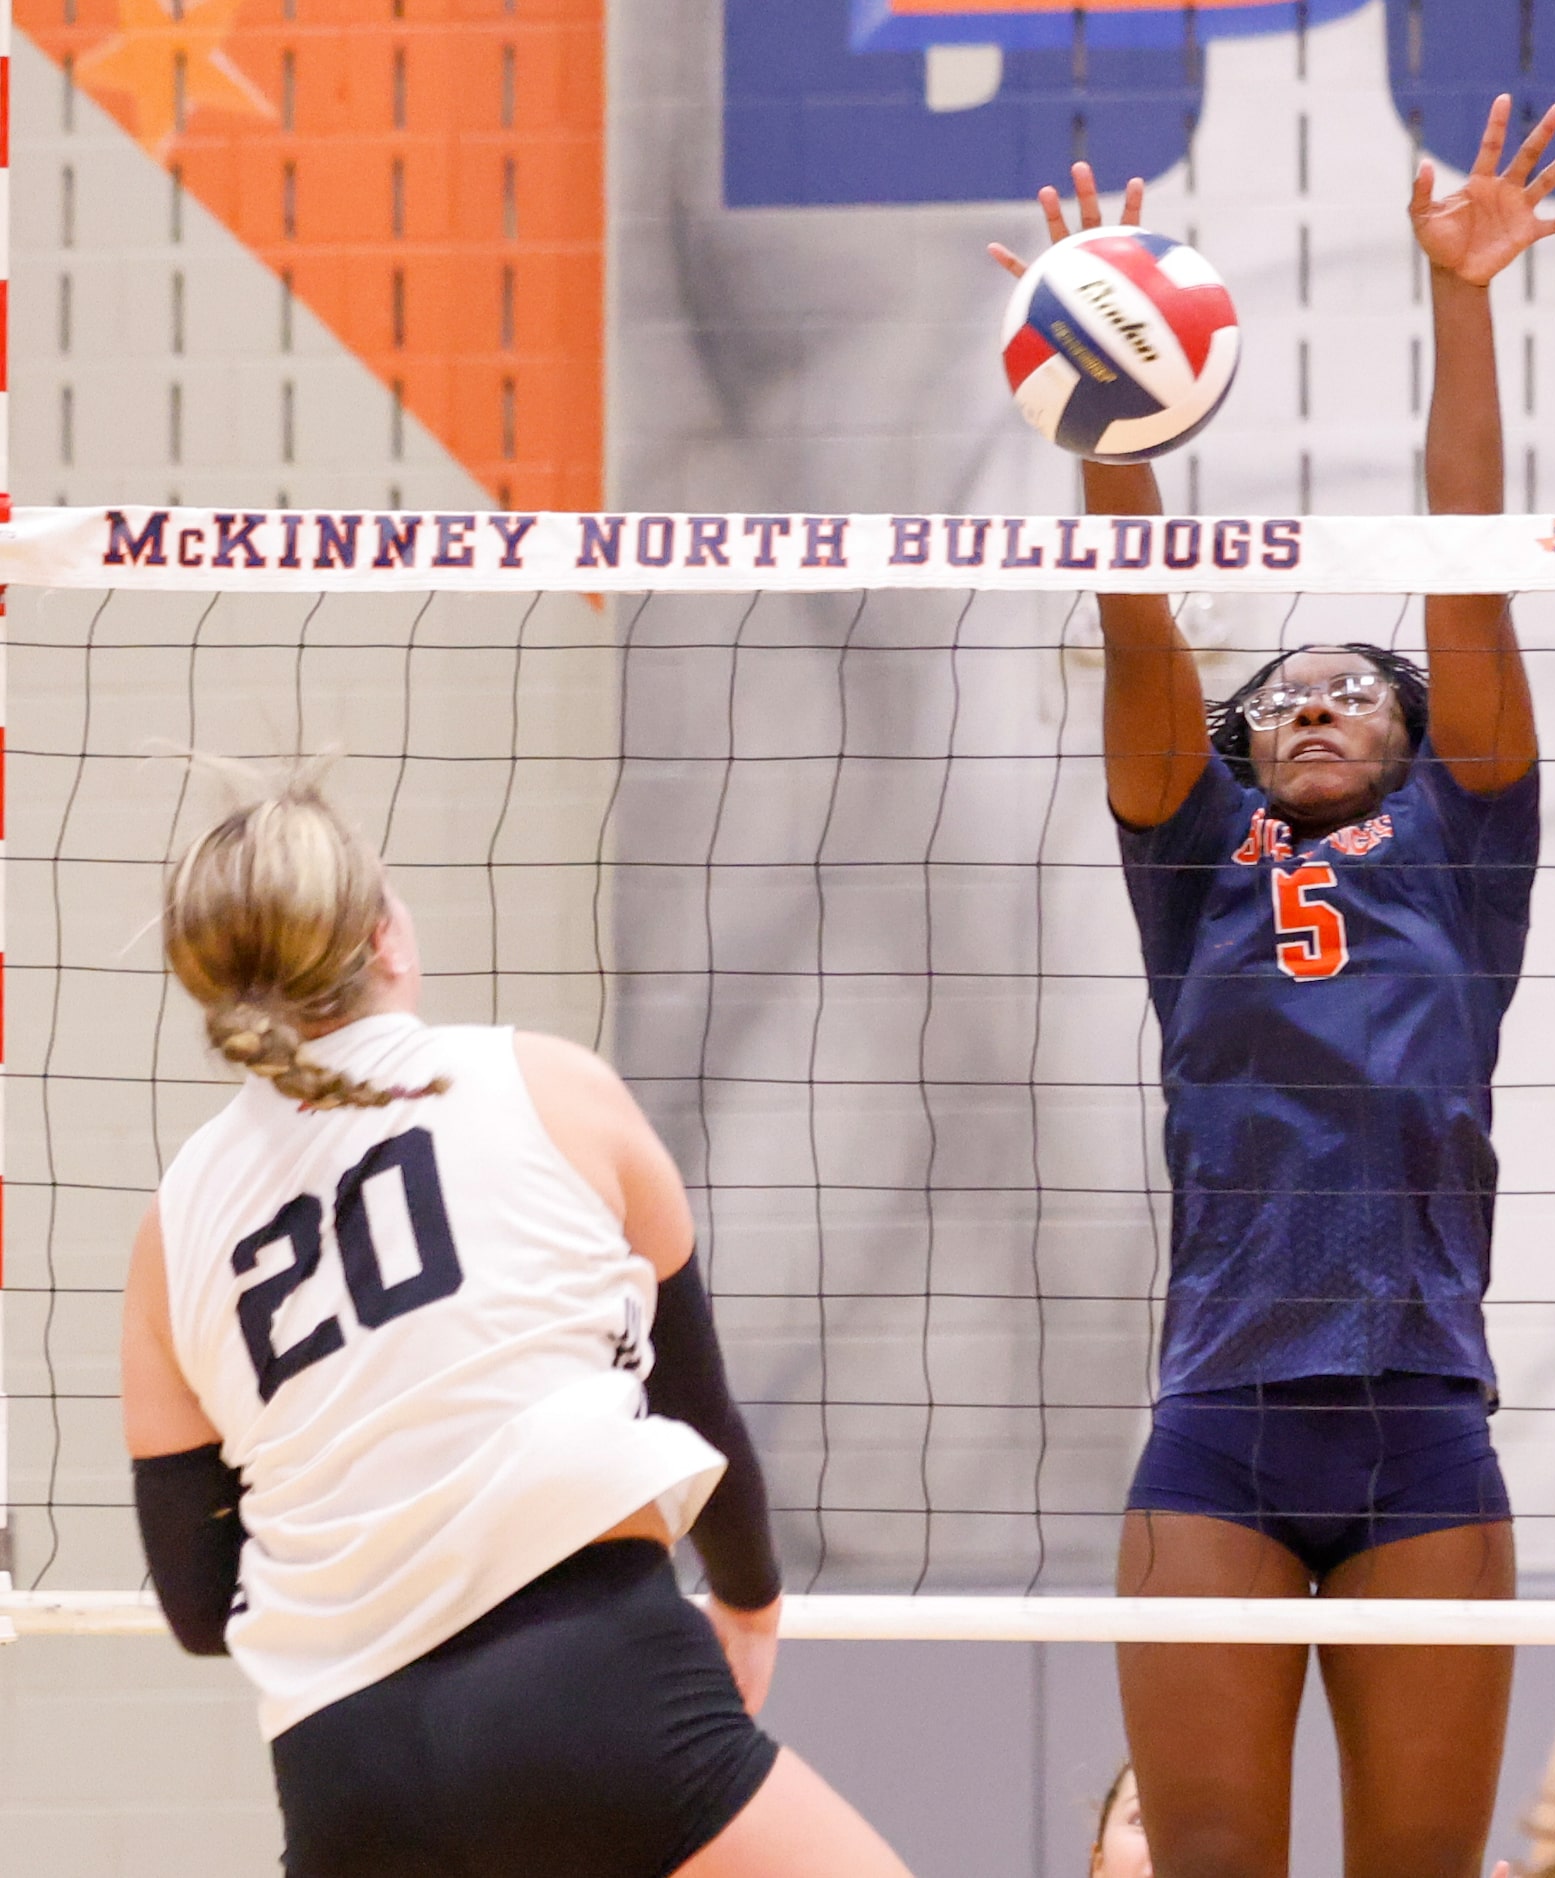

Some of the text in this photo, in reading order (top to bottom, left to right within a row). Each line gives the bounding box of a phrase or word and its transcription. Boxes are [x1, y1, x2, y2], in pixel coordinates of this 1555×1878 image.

[102, 511, 1301, 570] McKINNEY NORTH BULLDOGS
[1271, 861, 1350, 982] 5
[231, 1125, 465, 1404] 20
